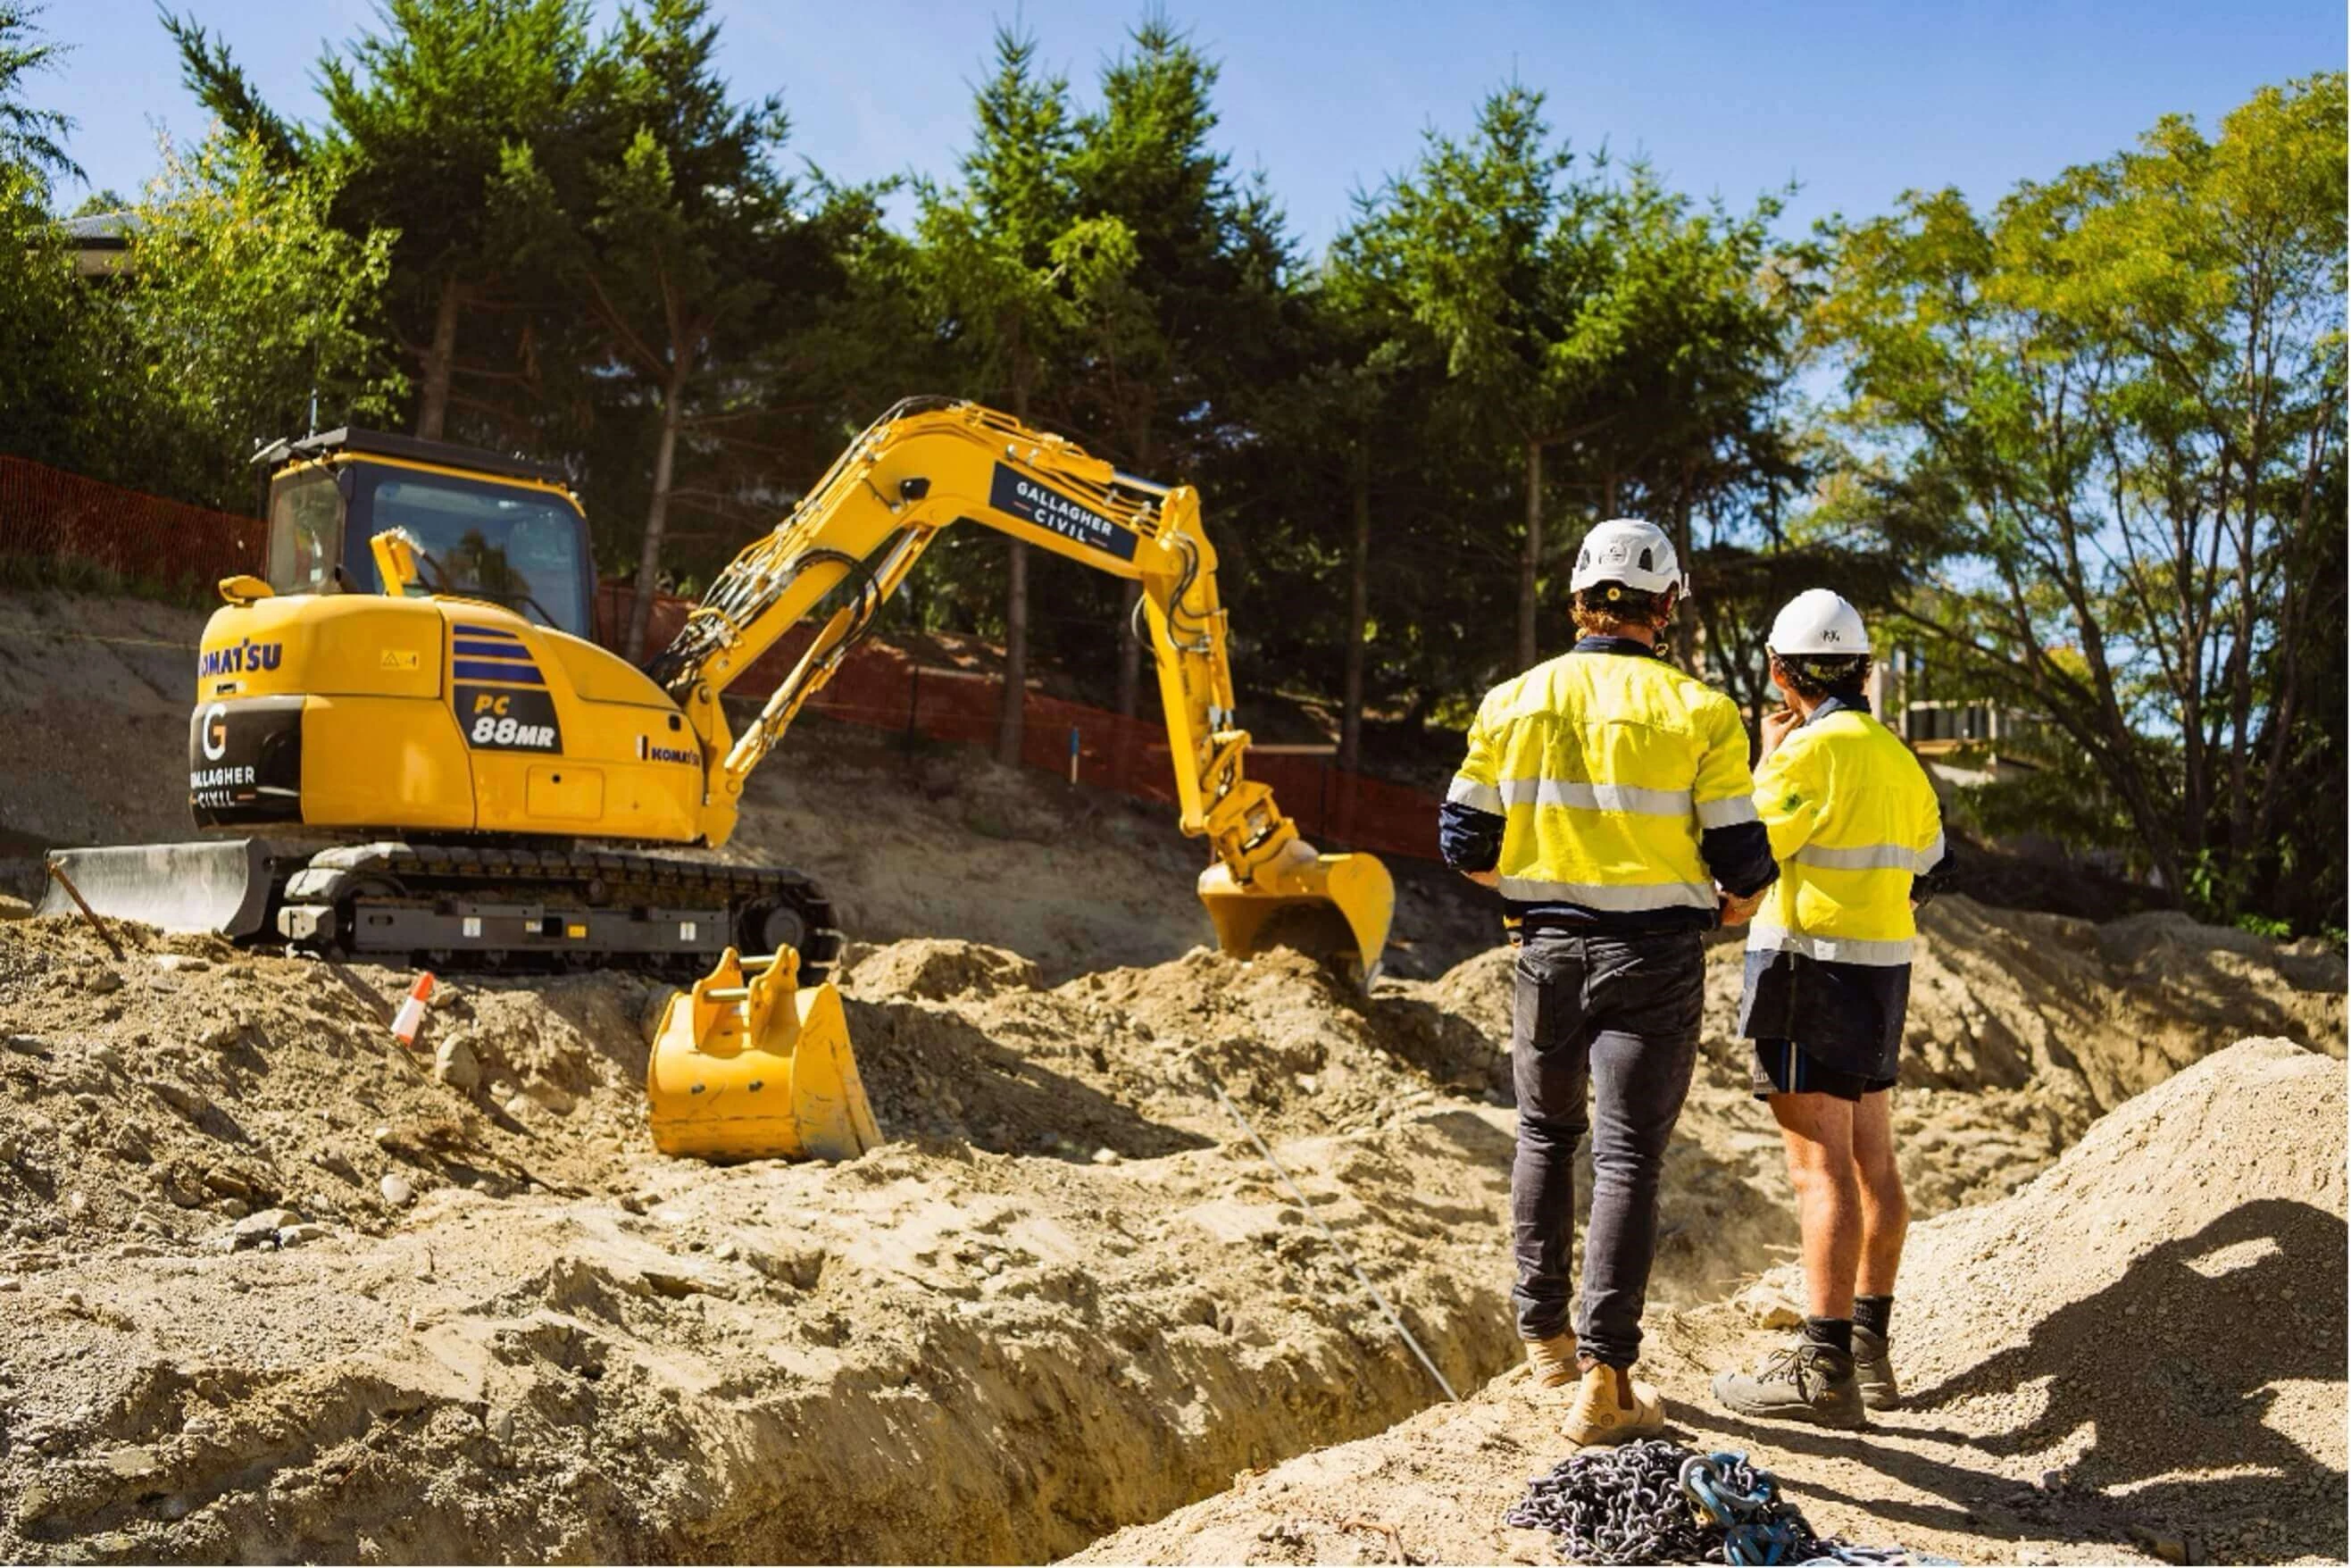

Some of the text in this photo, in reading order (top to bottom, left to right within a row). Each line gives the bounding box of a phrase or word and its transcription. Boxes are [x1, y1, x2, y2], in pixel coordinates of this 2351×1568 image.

[1016, 481, 1113, 536] GALLAGHER
[1034, 509, 1086, 543] CIVIL
[473, 694, 511, 715] PC
[203, 703, 227, 761] G
[471, 716, 555, 746] 88MR
[197, 790, 236, 808] CIVIL
